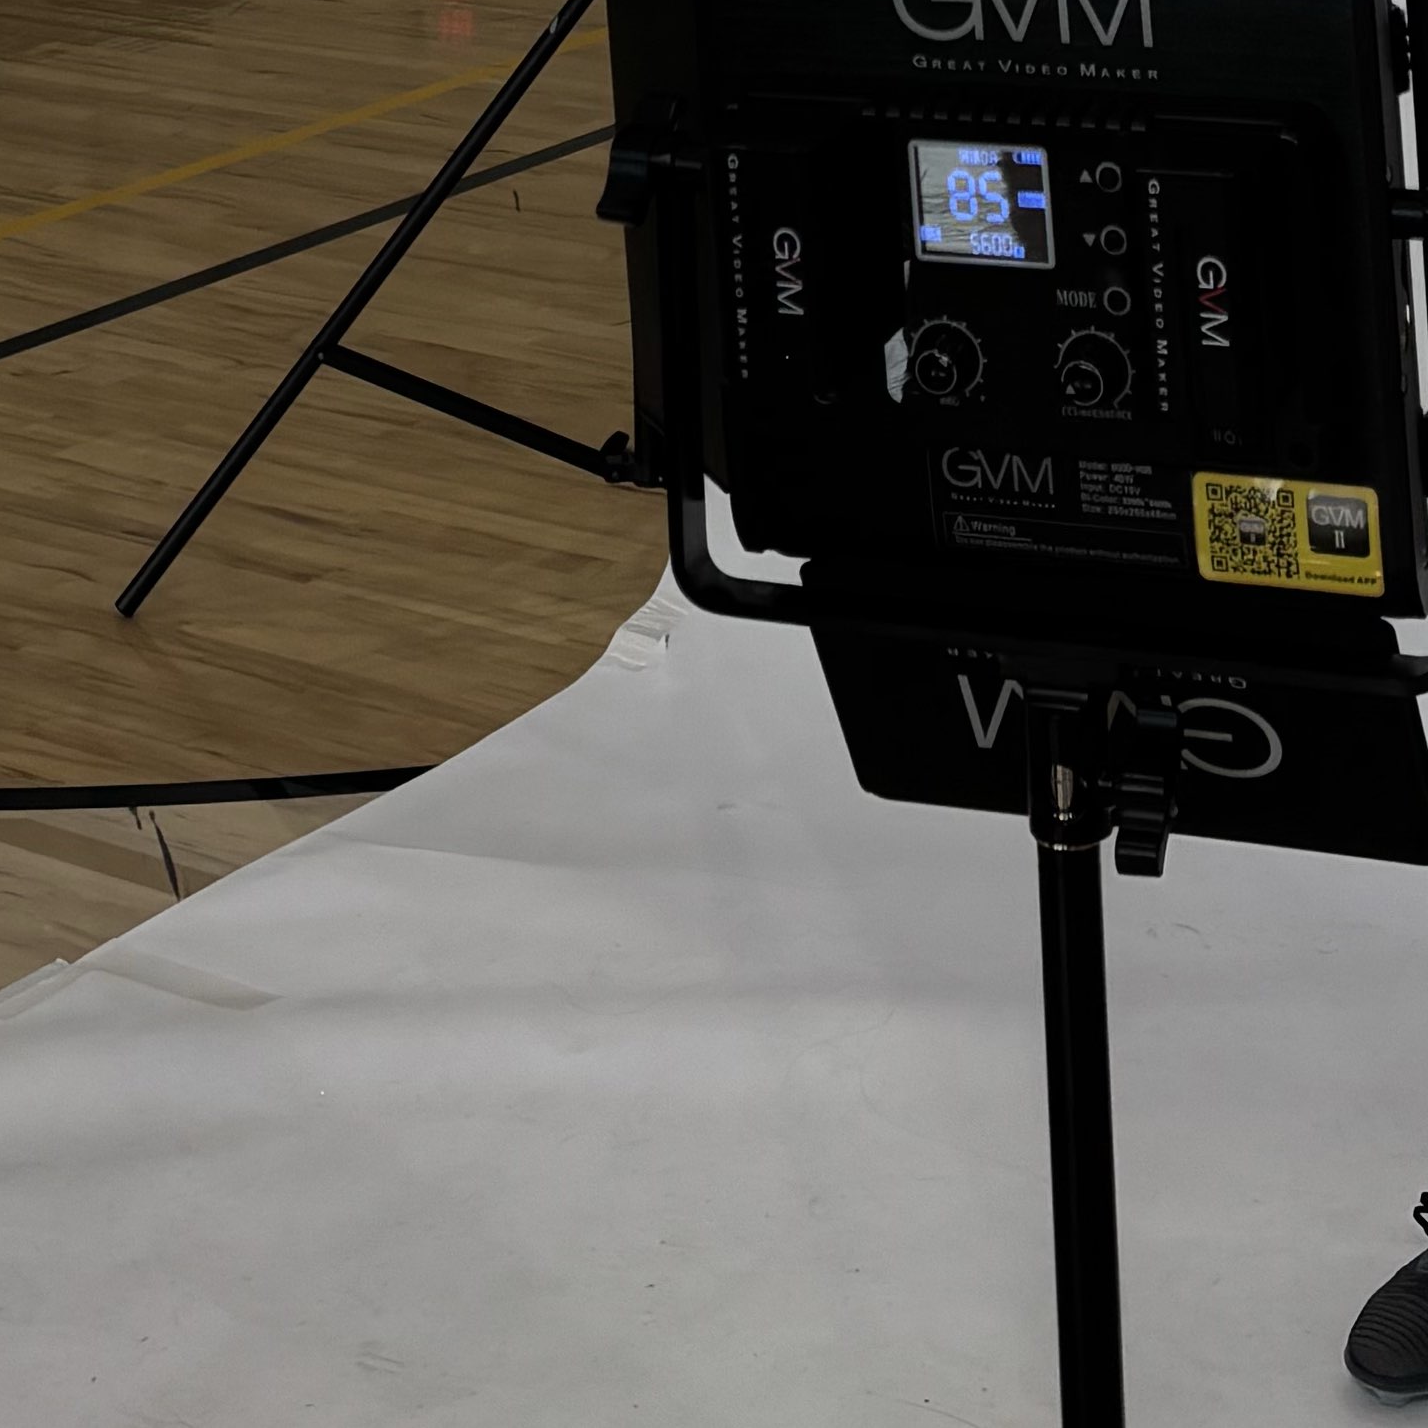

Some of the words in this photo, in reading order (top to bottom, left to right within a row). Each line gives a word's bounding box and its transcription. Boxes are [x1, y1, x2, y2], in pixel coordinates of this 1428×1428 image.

[946, 167, 1010, 224] 85
[772, 226, 805, 316] GVM
[1056, 288, 1097, 309] MODE
[1196, 255, 1231, 348] GVM
[941, 446, 1055, 496] GVM
[970, 519, 1017, 537] Warning
[1310, 505, 1366, 530] GVM
